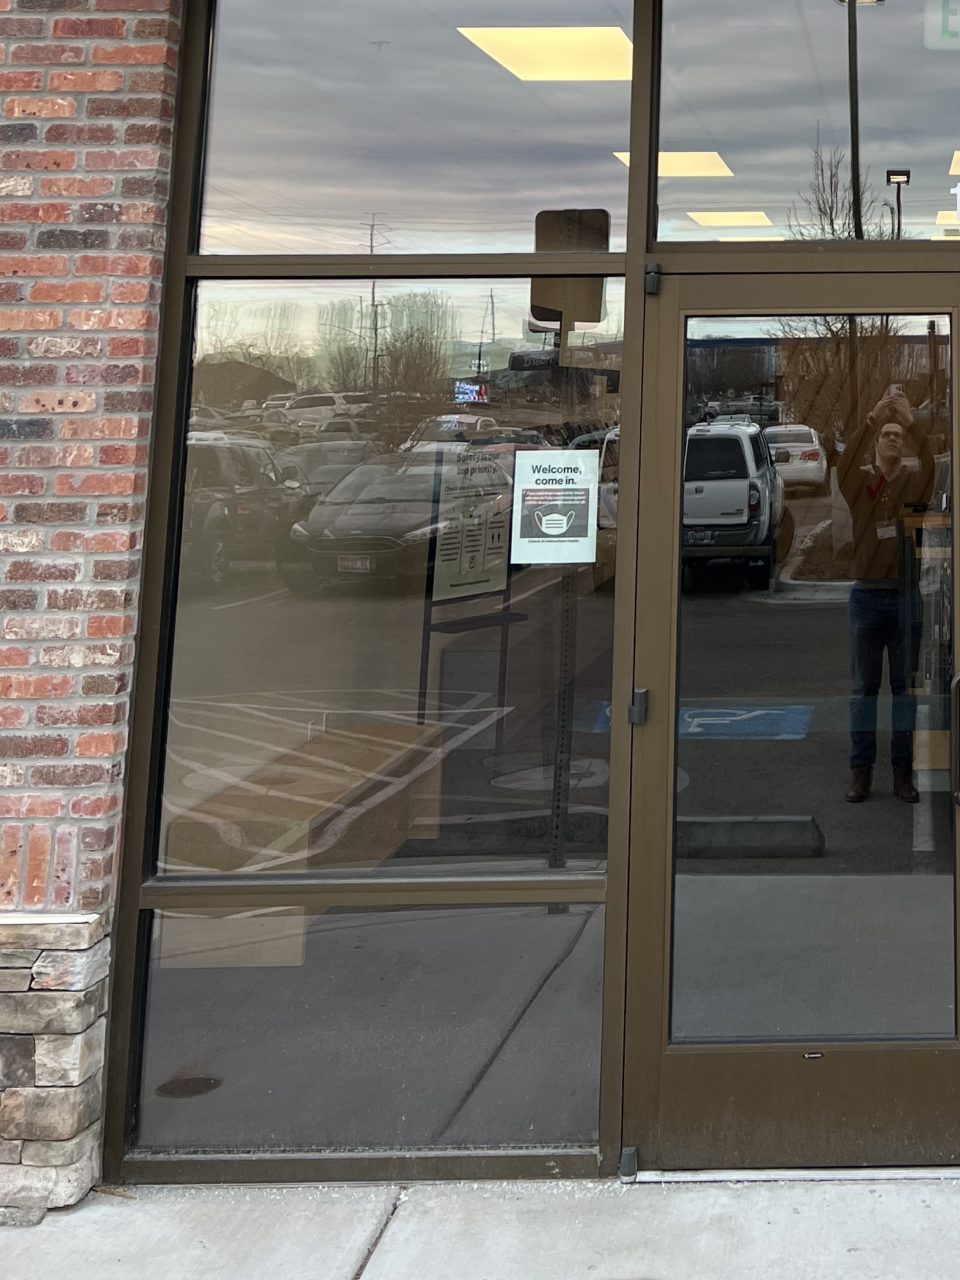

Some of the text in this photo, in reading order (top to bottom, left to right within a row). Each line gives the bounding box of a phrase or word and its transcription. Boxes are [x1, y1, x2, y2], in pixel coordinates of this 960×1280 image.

[531, 464, 582, 475] Welcome,
[535, 476, 577, 485] come in.
